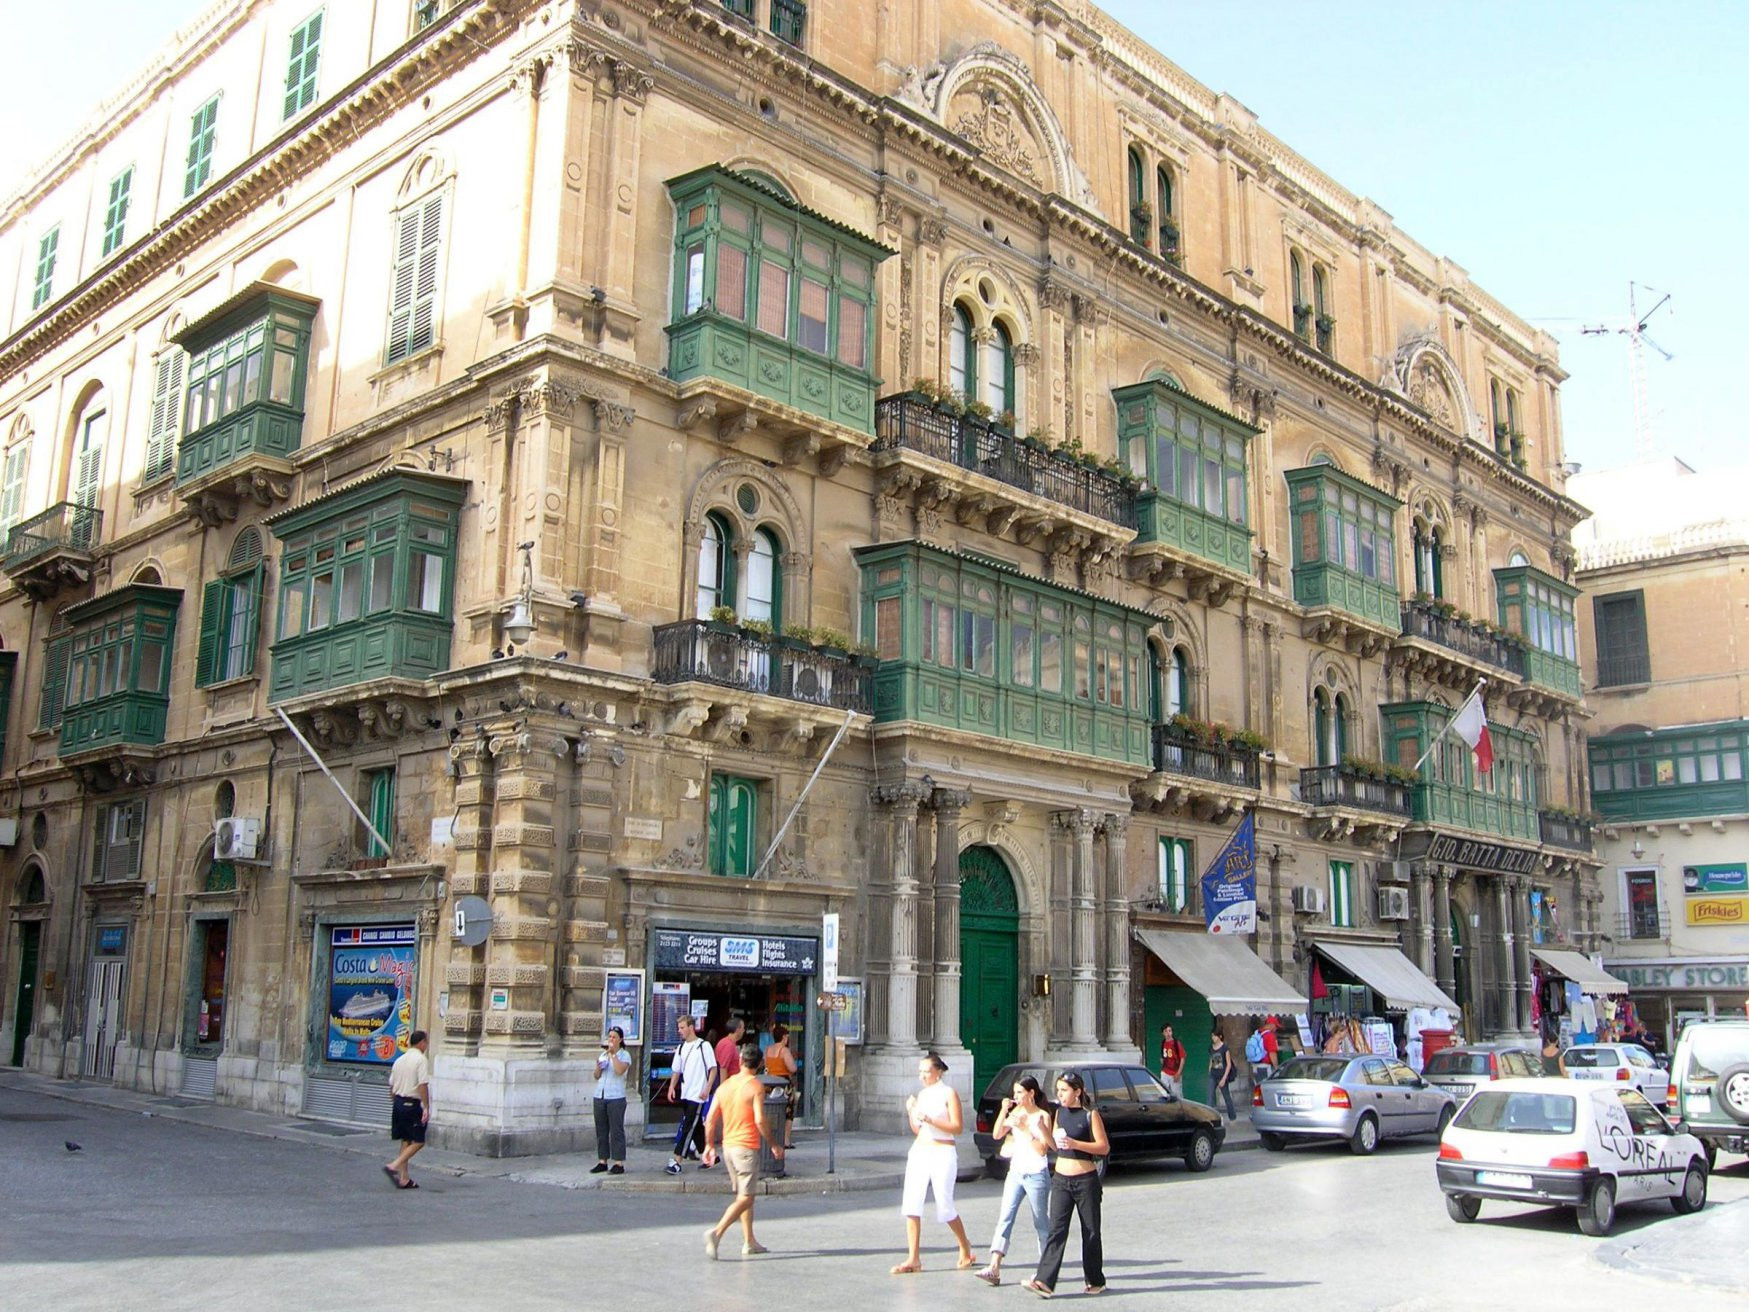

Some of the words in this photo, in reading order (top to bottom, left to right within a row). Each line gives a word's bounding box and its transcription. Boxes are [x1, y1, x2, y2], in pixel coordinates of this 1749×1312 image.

[1432, 838, 1457, 861] GIO.
[1458, 841, 1501, 868] BATTA
[1501, 849, 1537, 873] DELIA
[1697, 904, 1739, 917] Friskies
[689, 935, 717, 947] Groups
[762, 940, 786, 950] Hotels
[687, 945, 717, 955] Cruises
[725, 940, 755, 954] SMS
[684, 954, 698, 964] Car
[700, 955, 716, 964] Hire
[762, 949, 785, 960] Flights
[335, 954, 366, 973] Costa
[762, 958, 797, 968] Insurance
